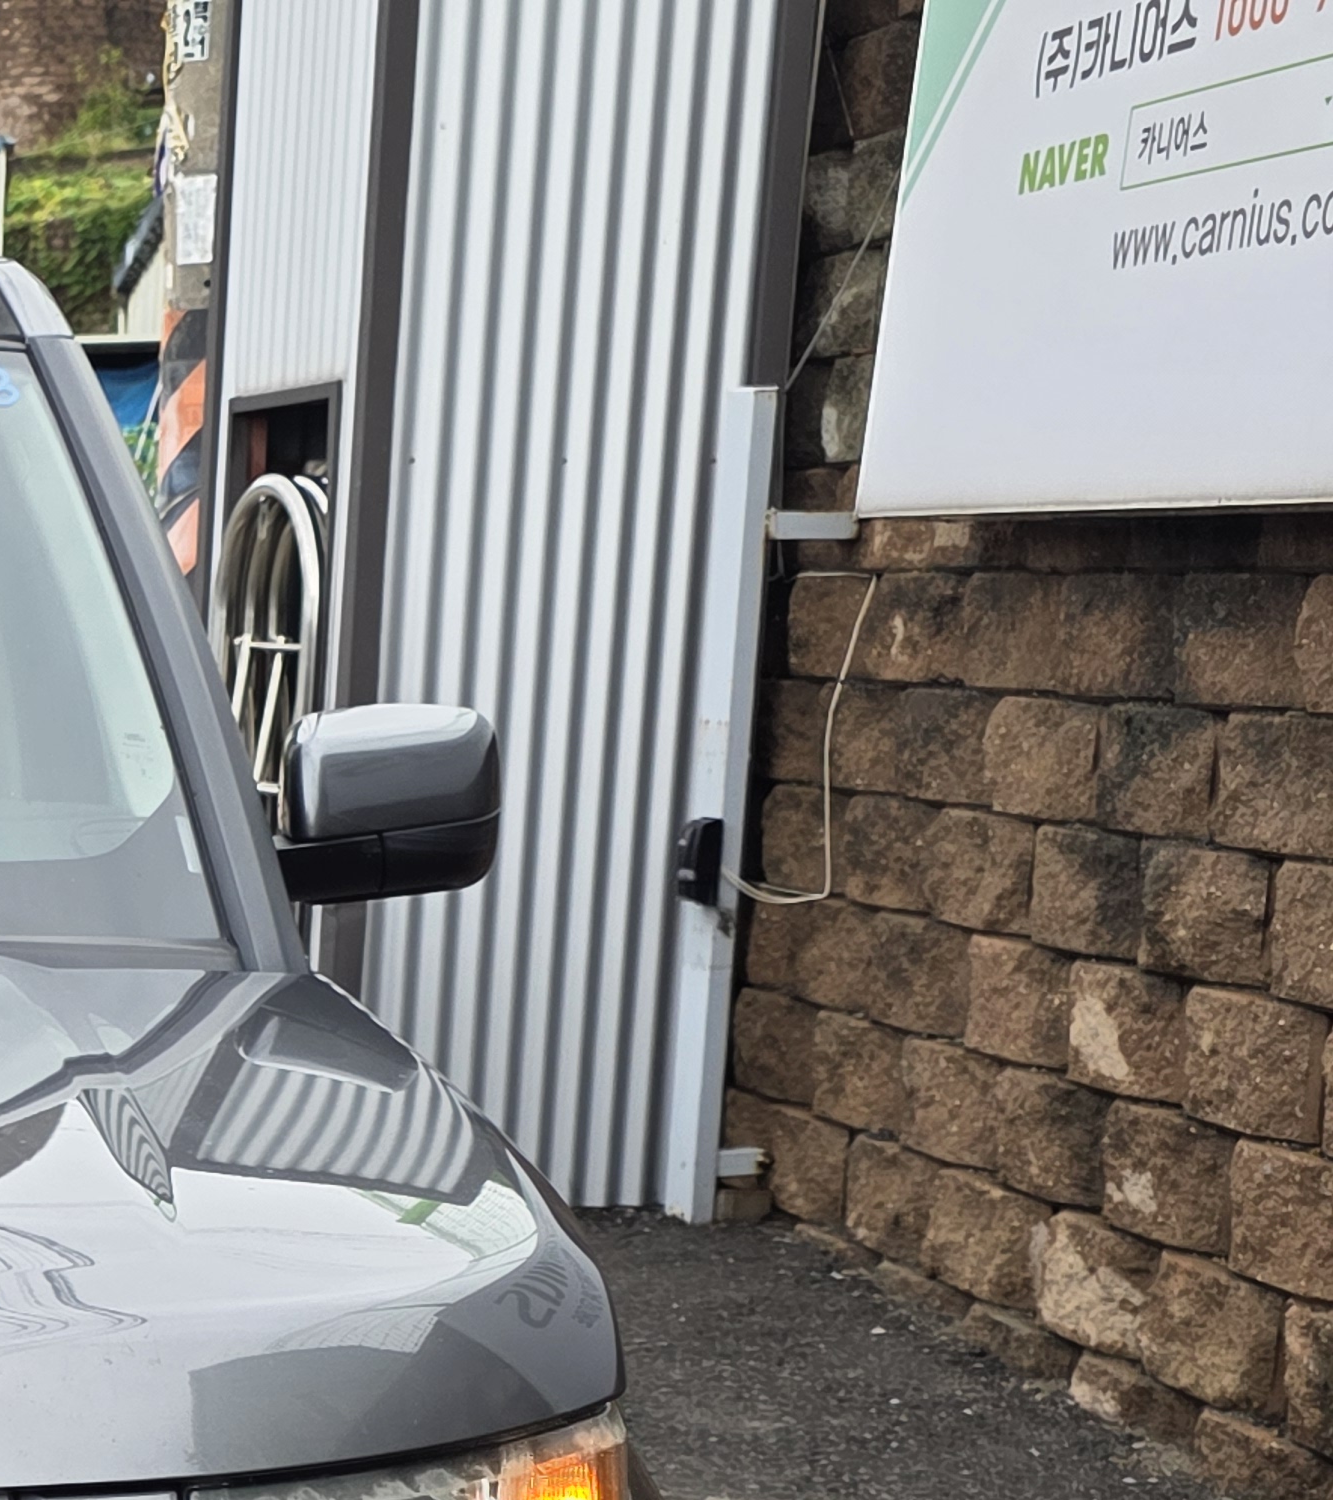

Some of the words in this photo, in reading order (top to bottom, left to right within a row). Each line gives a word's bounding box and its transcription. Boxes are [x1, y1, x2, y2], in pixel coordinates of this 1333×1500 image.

[1035, 0, 1198, 98] (주)카니어스
[1018, 133, 1110, 195] NAVER
[1137, 111, 1209, 165] 카니어스
